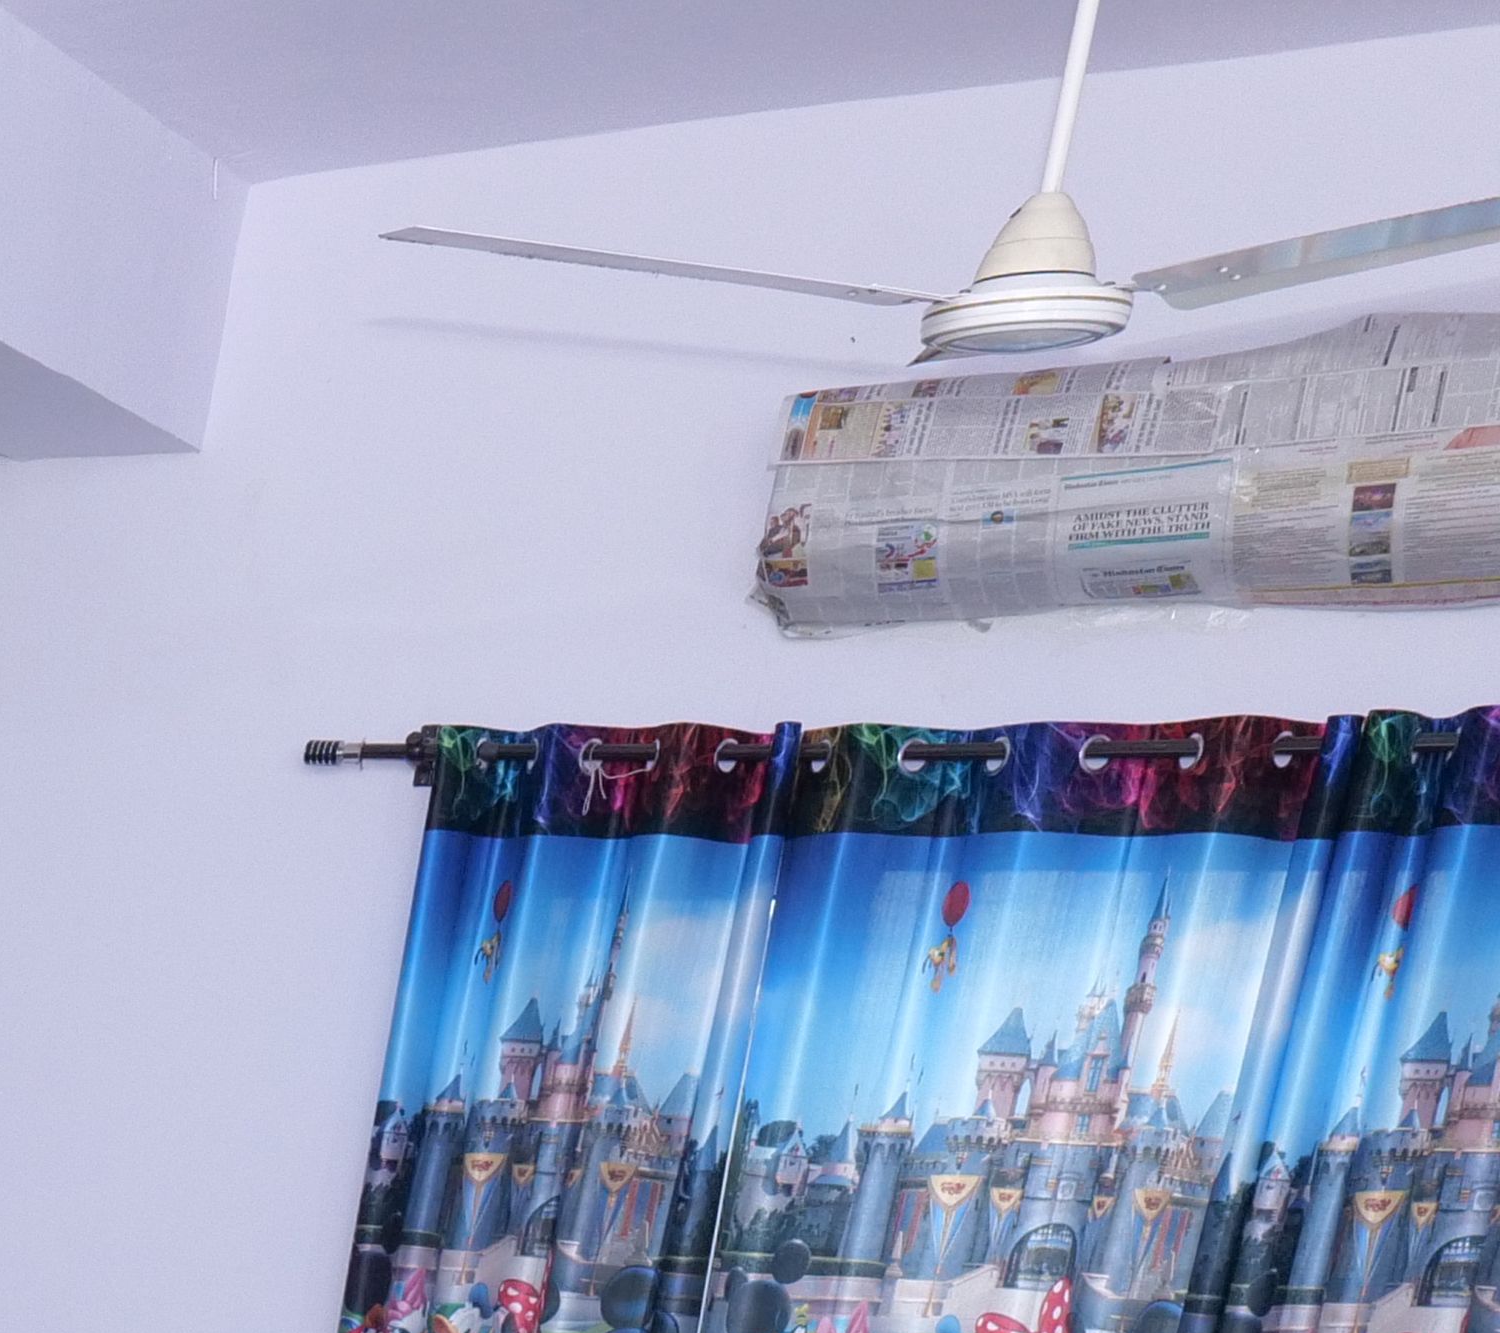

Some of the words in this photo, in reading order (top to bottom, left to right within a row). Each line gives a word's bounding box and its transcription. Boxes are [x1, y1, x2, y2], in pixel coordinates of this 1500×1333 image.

[1072, 522, 1090, 532] OF
[1091, 518, 1121, 531] FAKE
[1167, 511, 1209, 522] STAND
[1074, 511, 1121, 523] AMIDST
[1125, 507, 1149, 517] THE
[1152, 502, 1209, 515] CLUTTER
[1068, 531, 1099, 541] FIRM
[1103, 527, 1137, 539] WITH
[1140, 525, 1164, 535] THE
[1168, 521, 1210, 533] TRUTH
